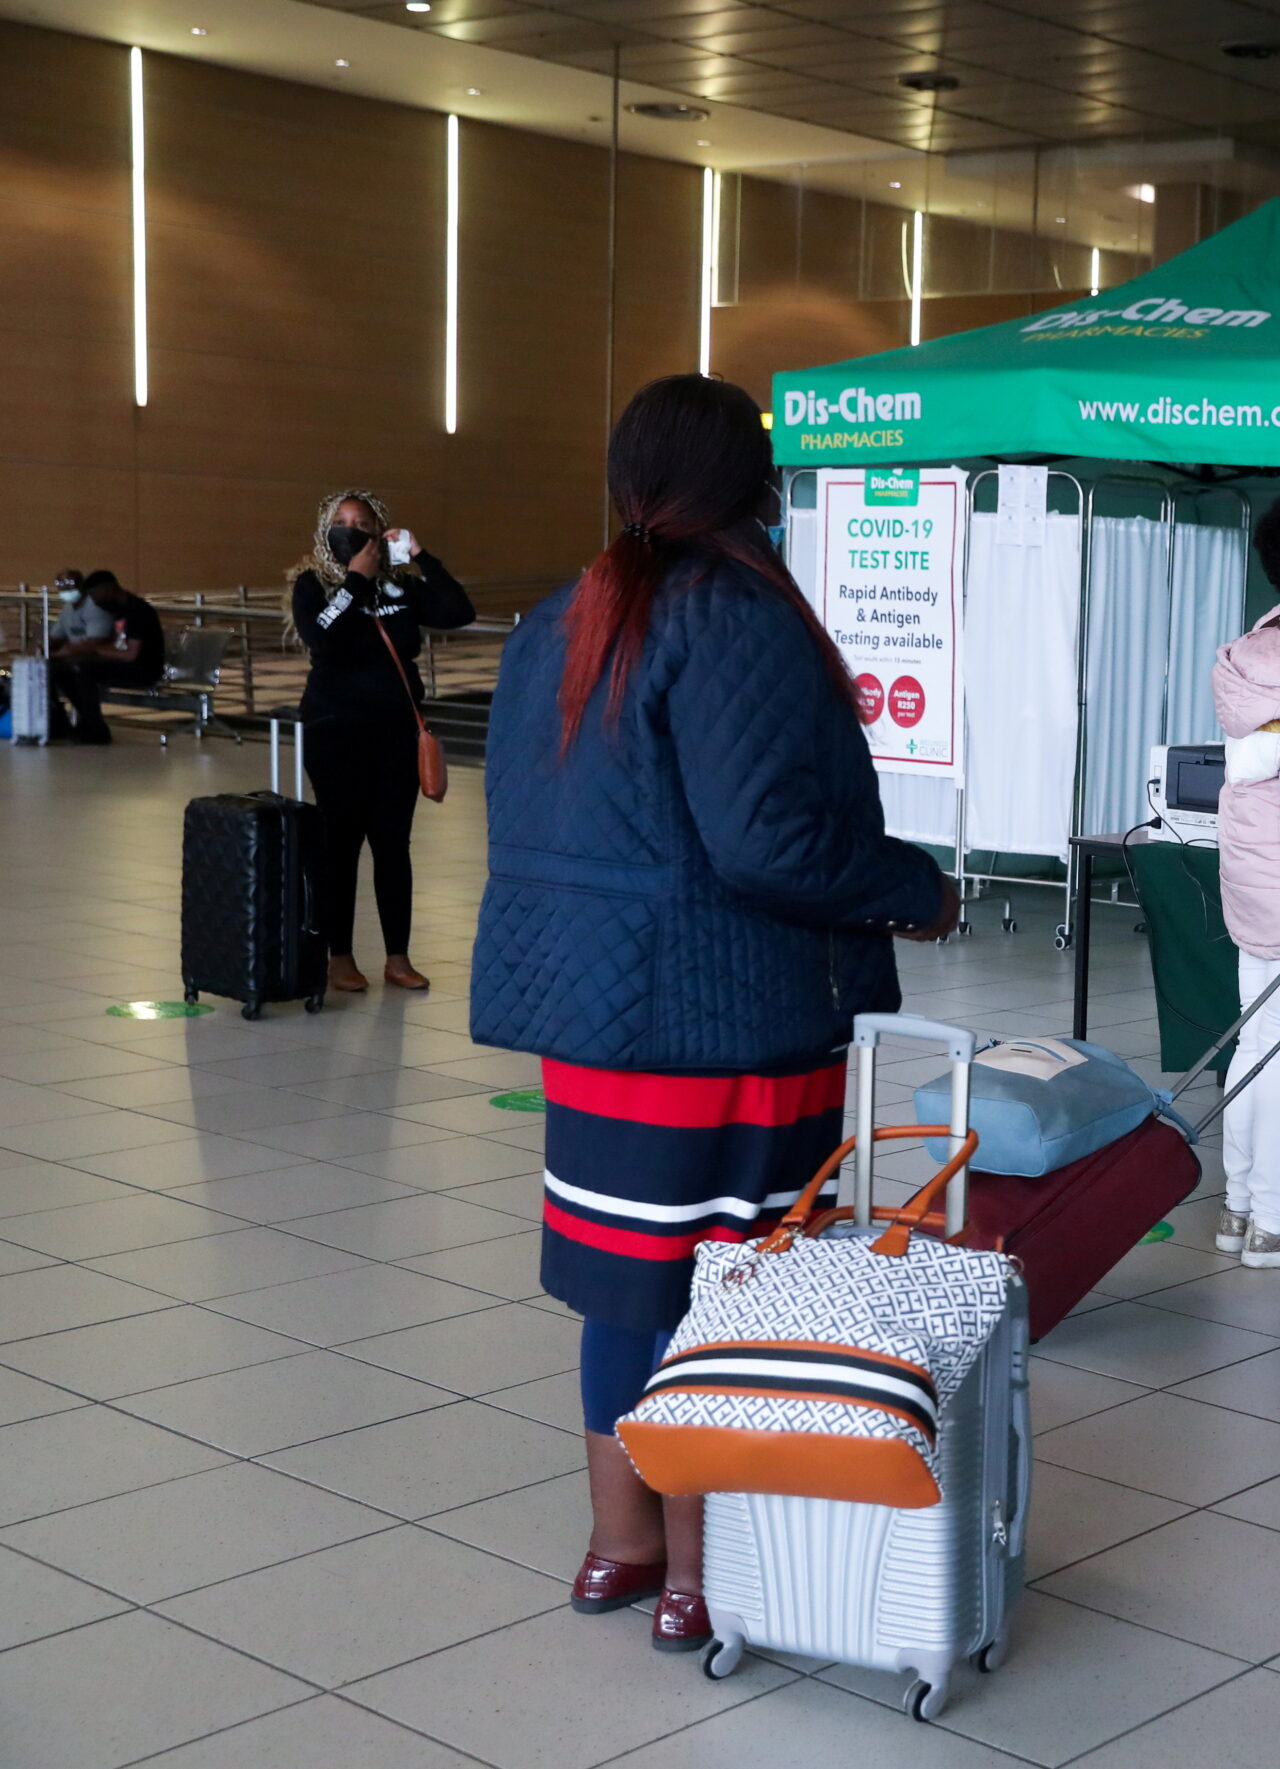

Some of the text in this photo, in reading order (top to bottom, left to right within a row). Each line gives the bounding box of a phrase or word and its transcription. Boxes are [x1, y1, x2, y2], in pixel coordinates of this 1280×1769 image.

[1019, 298, 1271, 333] Dis-Chem
[1021, 325, 1210, 342] PHARMACIES
[784, 387, 922, 426] Dis-Chem
[800, 429, 904, 450] PHARMACIES
[871, 476, 914, 489] Dis-Chem
[847, 518, 933, 538] COVID-19
[848, 549, 930, 570] TEST SITE
[839, 584, 938, 606] Rapid Antibody
[856, 608, 920, 628] & Antigen
[834, 630, 943, 650] Testing available
[893, 690, 920, 701] Antigen
